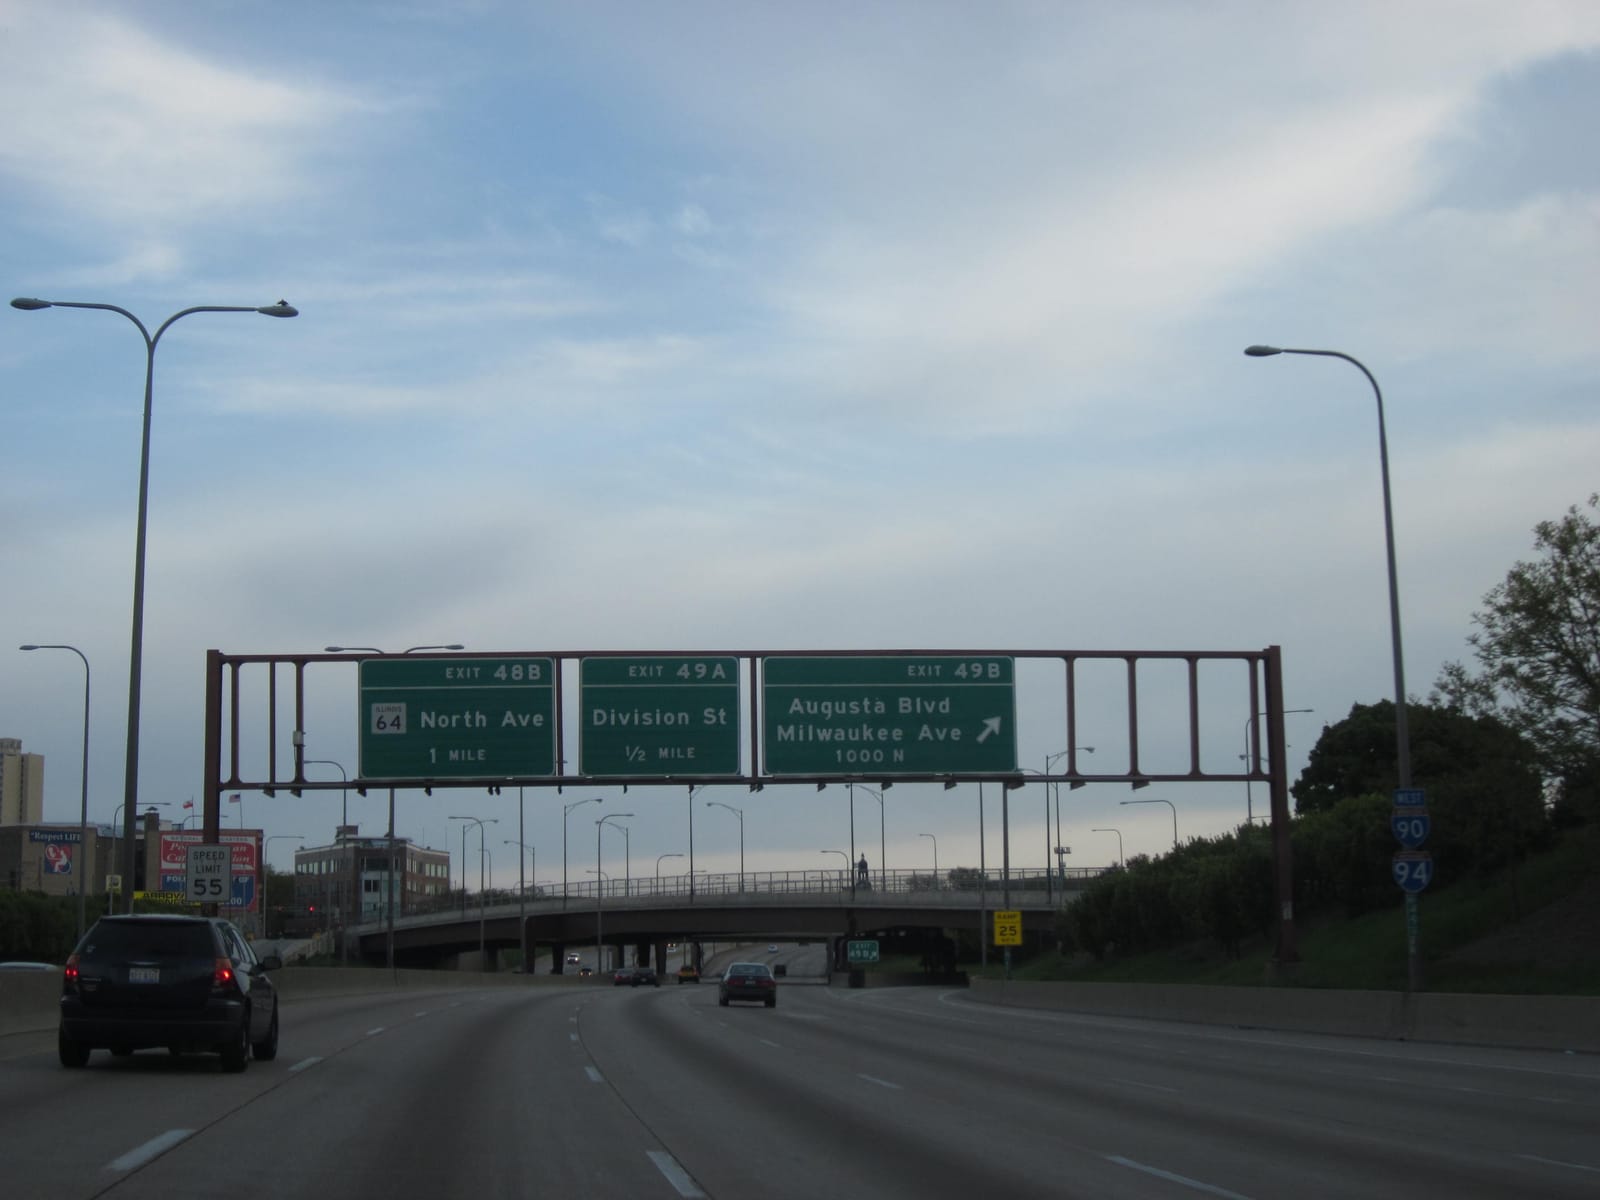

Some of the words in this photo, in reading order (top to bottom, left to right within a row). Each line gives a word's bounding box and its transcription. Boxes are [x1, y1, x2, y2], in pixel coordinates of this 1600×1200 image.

[445, 667, 480, 680] EXIT
[493, 664, 541, 681] 48B
[628, 665, 664, 677] EXIT
[676, 663, 726, 679] 49A
[907, 665, 942, 677] EXIT
[954, 662, 1000, 678] 49B
[592, 708, 689, 726] Division
[703, 707, 727, 725] St
[788, 697, 886, 720] Augusta
[897, 697, 951, 714] Blvd
[376, 715, 401, 730] 64
[420, 710, 487, 729] North
[501, 710, 544, 728] Ave
[777, 724, 904, 743] Milwaukee
[918, 724, 962, 742] Ave
[429, 748, 437, 763] 1
[448, 749, 487, 761] MILE
[658, 747, 696, 759] MILE
[836, 749, 884, 763] 1000
[893, 750, 904, 763] N
[1397, 819, 1425, 838] 90
[193, 850, 225, 861] SPEED
[195, 864, 222, 874] LIMIT
[1394, 861, 1427, 883] 94
[193, 879, 222, 896] 55
[999, 925, 1017, 937] 25
